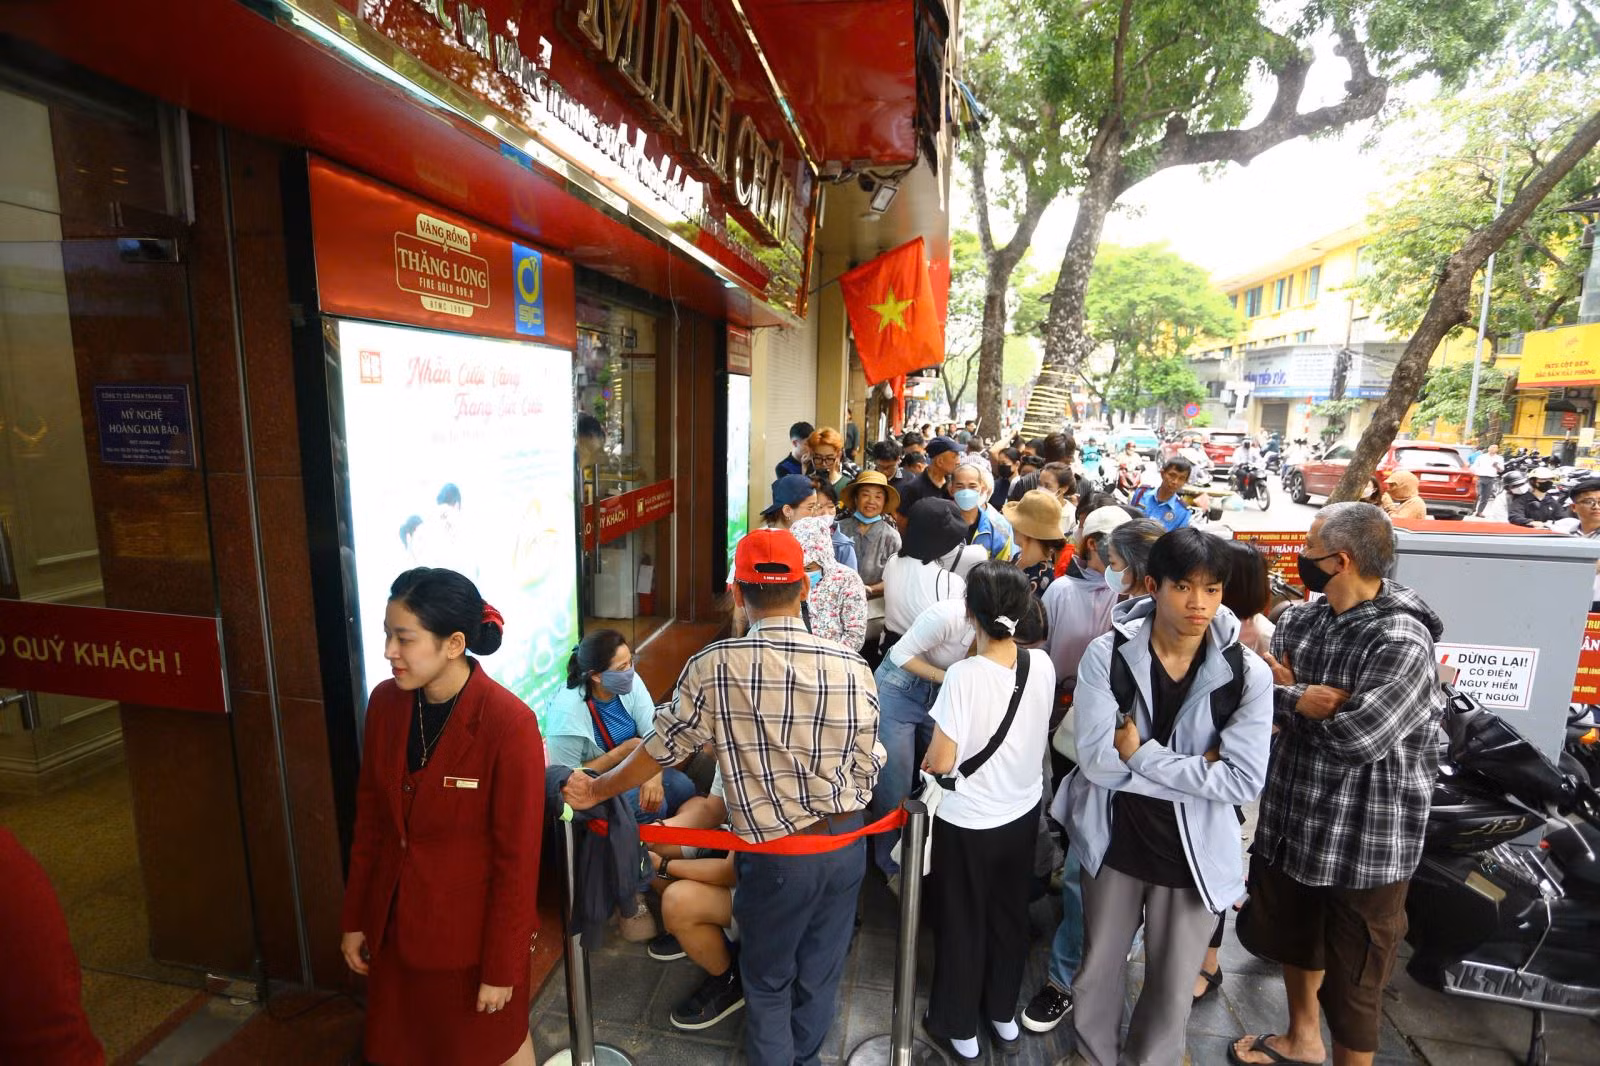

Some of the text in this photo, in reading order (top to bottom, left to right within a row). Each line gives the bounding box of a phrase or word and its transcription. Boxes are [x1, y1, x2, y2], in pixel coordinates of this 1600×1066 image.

[419, 219, 468, 247] VÀNG RỒNG
[397, 247, 486, 288] THĂNG LONG
[419, 277, 434, 290] FINE
[437, 281, 453, 295] GOLD
[121, 407, 164, 421] MỸ NGHỆ
[108, 421, 179, 434] HOÀNG KIM BẢO
[1271, 543, 1292, 553] NHÂN
[1580, 635, 1600, 650] ÂN
[13, 635, 65, 663] QUÝ
[74, 640, 166, 673] KHÁCH
[1458, 652, 1528, 668] DỪNG LẠI!
[1487, 668, 1512, 678] ĐIỆN
[1459, 679, 1518, 690] NGUY HIỂM
[1486, 693, 1519, 702] NGƯỜI
